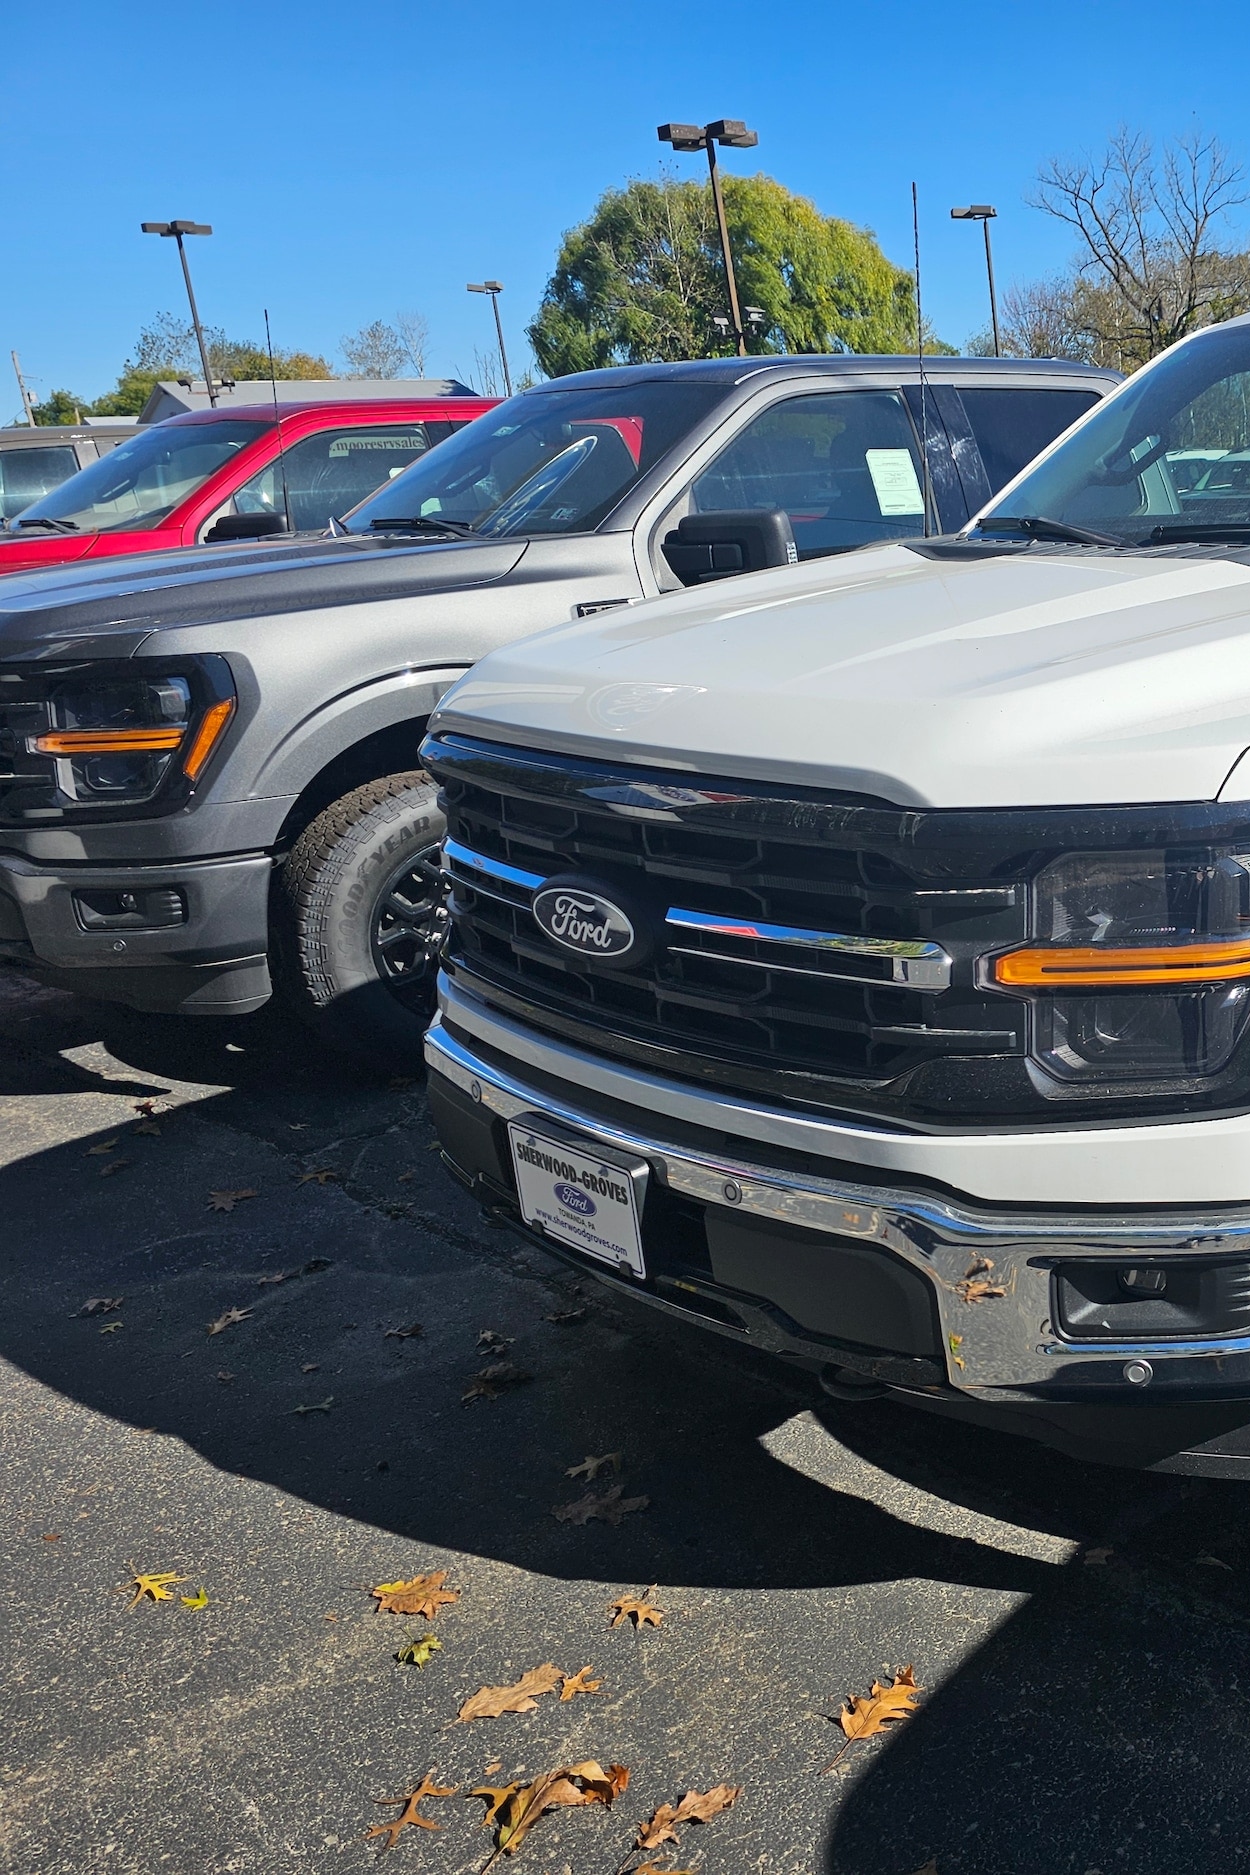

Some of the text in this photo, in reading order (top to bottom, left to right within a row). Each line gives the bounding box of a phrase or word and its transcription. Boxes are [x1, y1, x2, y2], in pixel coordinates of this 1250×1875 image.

[551, 895, 612, 949] Ford
[516, 1141, 629, 1206] SHERWOOD-GROVES
[561, 1186, 588, 1212] Ford
[535, 1207, 628, 1257] www.sherwoodgroves.com
